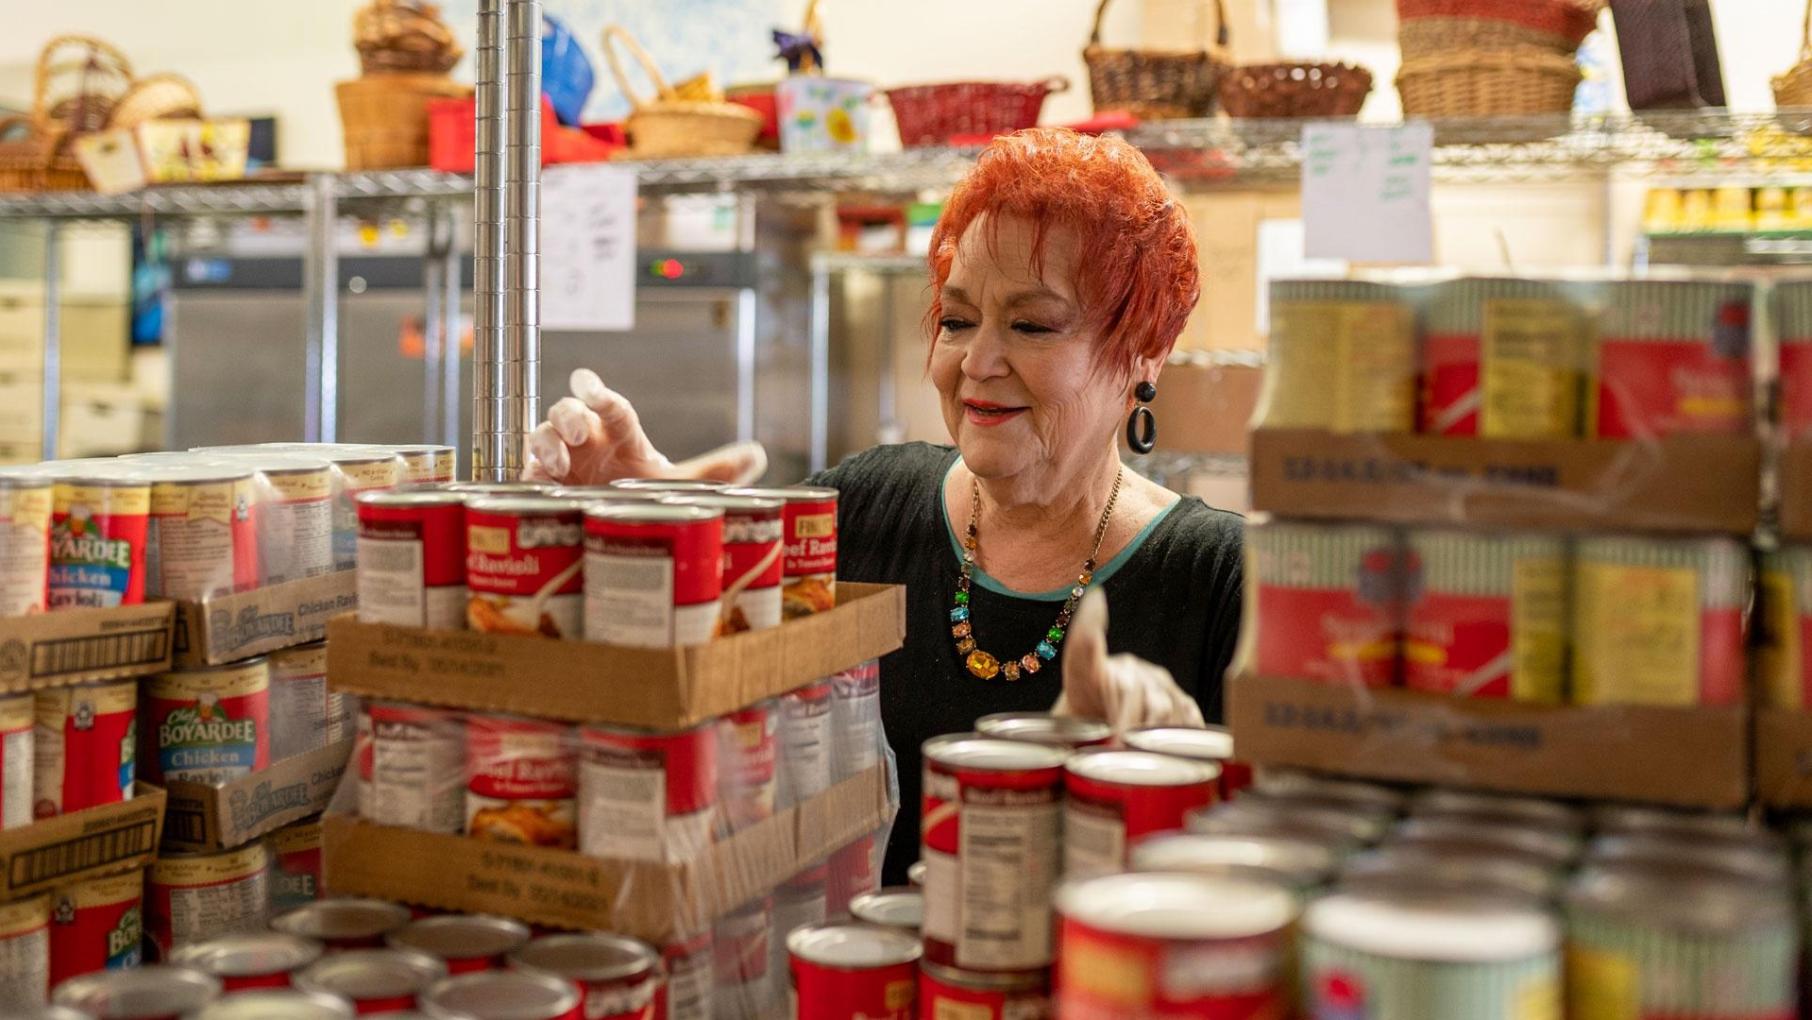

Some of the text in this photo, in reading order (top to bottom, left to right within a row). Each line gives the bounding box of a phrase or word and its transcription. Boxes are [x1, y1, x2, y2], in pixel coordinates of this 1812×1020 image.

[51, 535, 130, 568] YARDEE
[783, 539, 807, 557] eef
[50, 565, 112, 586] hicken
[166, 709, 196, 724] Chef
[159, 719, 255, 747] BOYARDEE
[171, 750, 240, 767] Chicken
